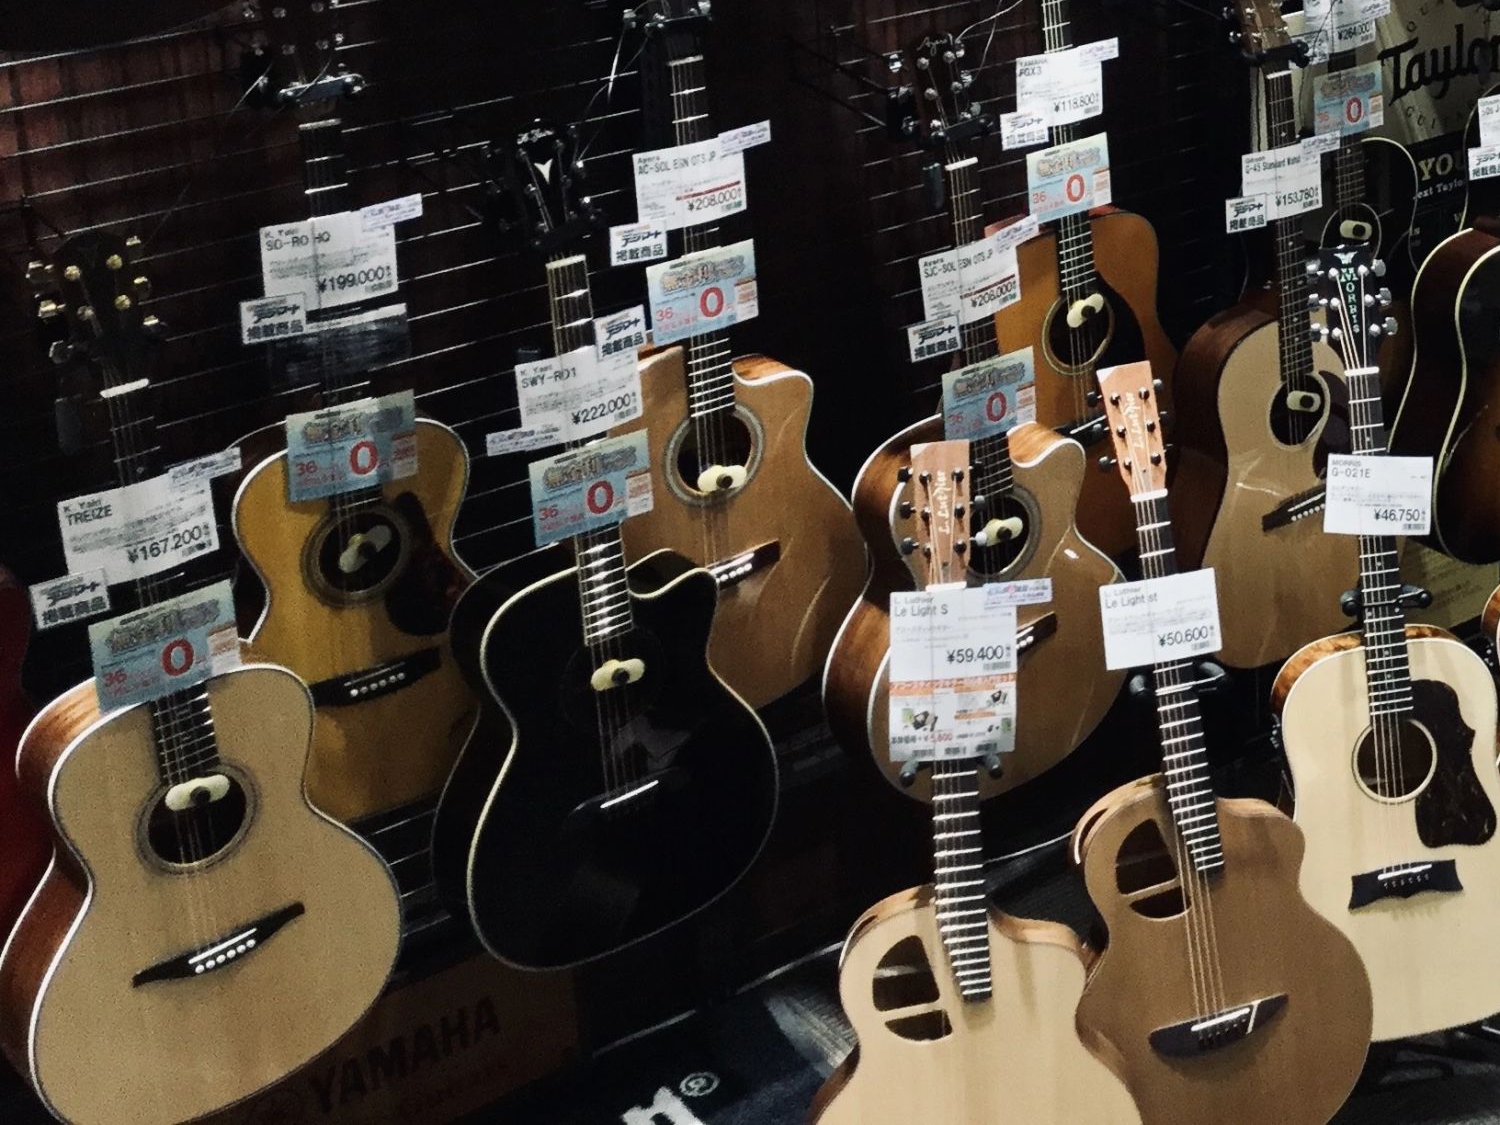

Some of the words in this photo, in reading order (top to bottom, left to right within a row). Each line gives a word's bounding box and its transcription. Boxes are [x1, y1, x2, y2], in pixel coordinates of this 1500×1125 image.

[1345, 96, 1363, 124] 0
[1065, 173, 1085, 203] 0
[699, 286, 725, 318] 0
[985, 390, 1007, 423] 0
[349, 441, 380, 476] 0
[1331, 468, 1371, 480] G-021E
[586, 479, 616, 515] 0
[66, 504, 114, 526] TREIZE
[1374, 507, 1422, 524] ¥46,750
[893, 605, 907, 617] Le
[911, 603, 938, 618] Light
[940, 603, 949, 615] S
[1121, 593, 1146, 608] Light
[1158, 625, 1209, 648] ¥50,600
[160, 637, 196, 676] 0
[946, 644, 1005, 664] ¥59,400
